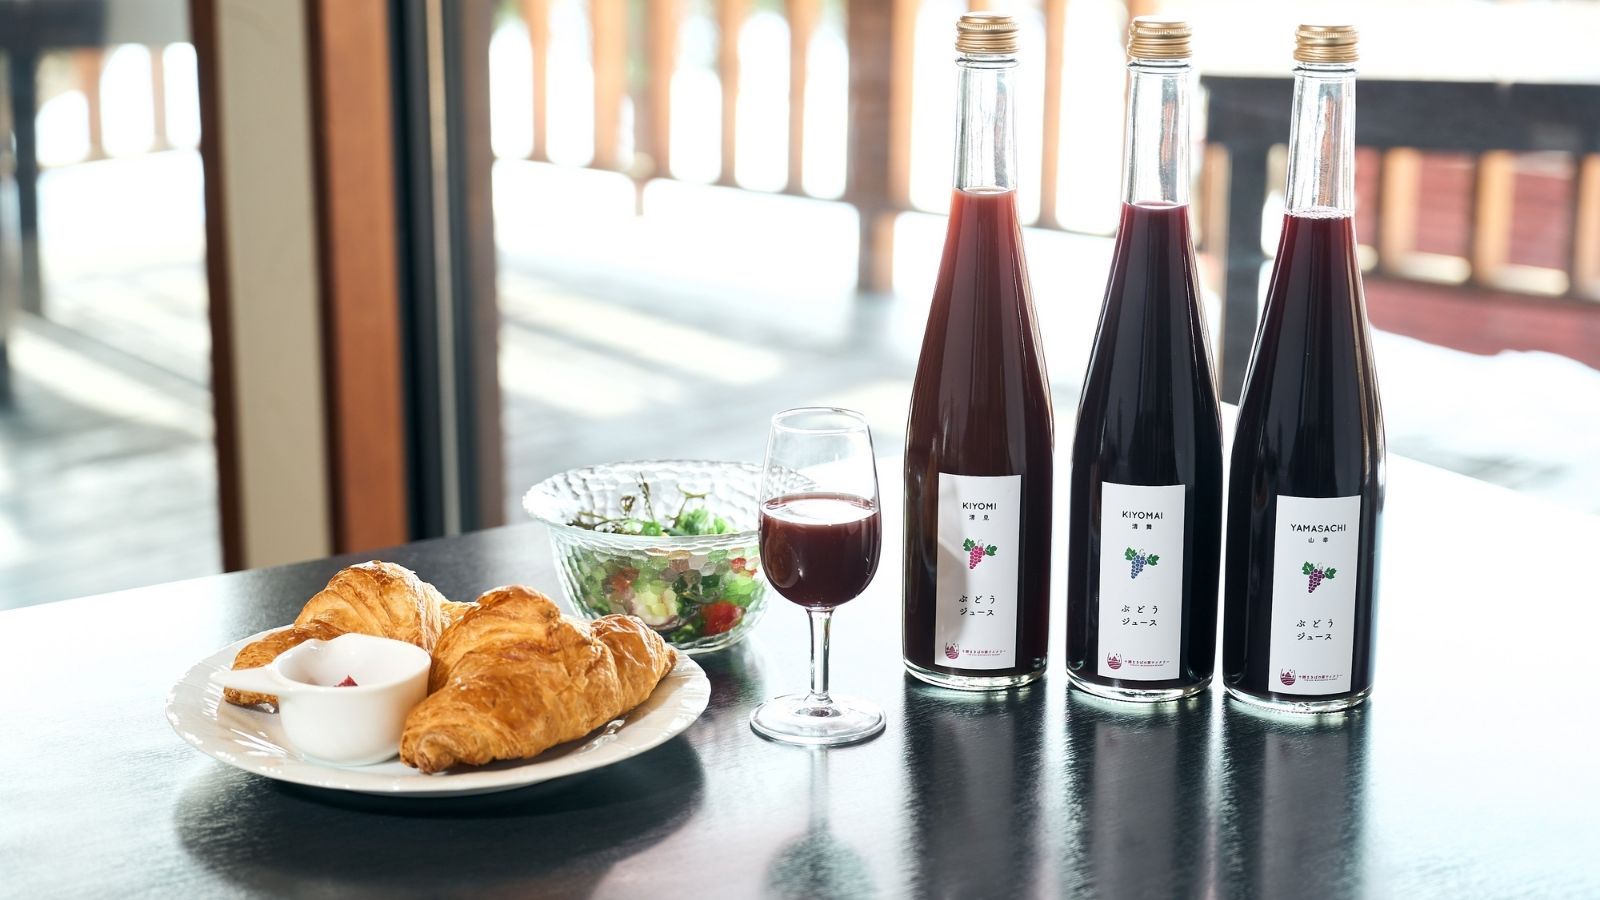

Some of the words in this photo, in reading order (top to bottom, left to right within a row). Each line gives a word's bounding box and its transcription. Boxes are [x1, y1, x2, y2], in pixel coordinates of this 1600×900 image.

[962, 502, 997, 510] KIYOMI
[1122, 511, 1163, 520] KIYOMAI
[1290, 523, 1347, 533] YAMASACHI
[959, 595, 996, 605] ぶどう
[960, 607, 994, 616] ジュース
[1121, 605, 1158, 614] ぶどう
[1122, 617, 1157, 627] ジュース
[1296, 619, 1334, 628] ぶどう
[1297, 632, 1332, 641] ジュース
